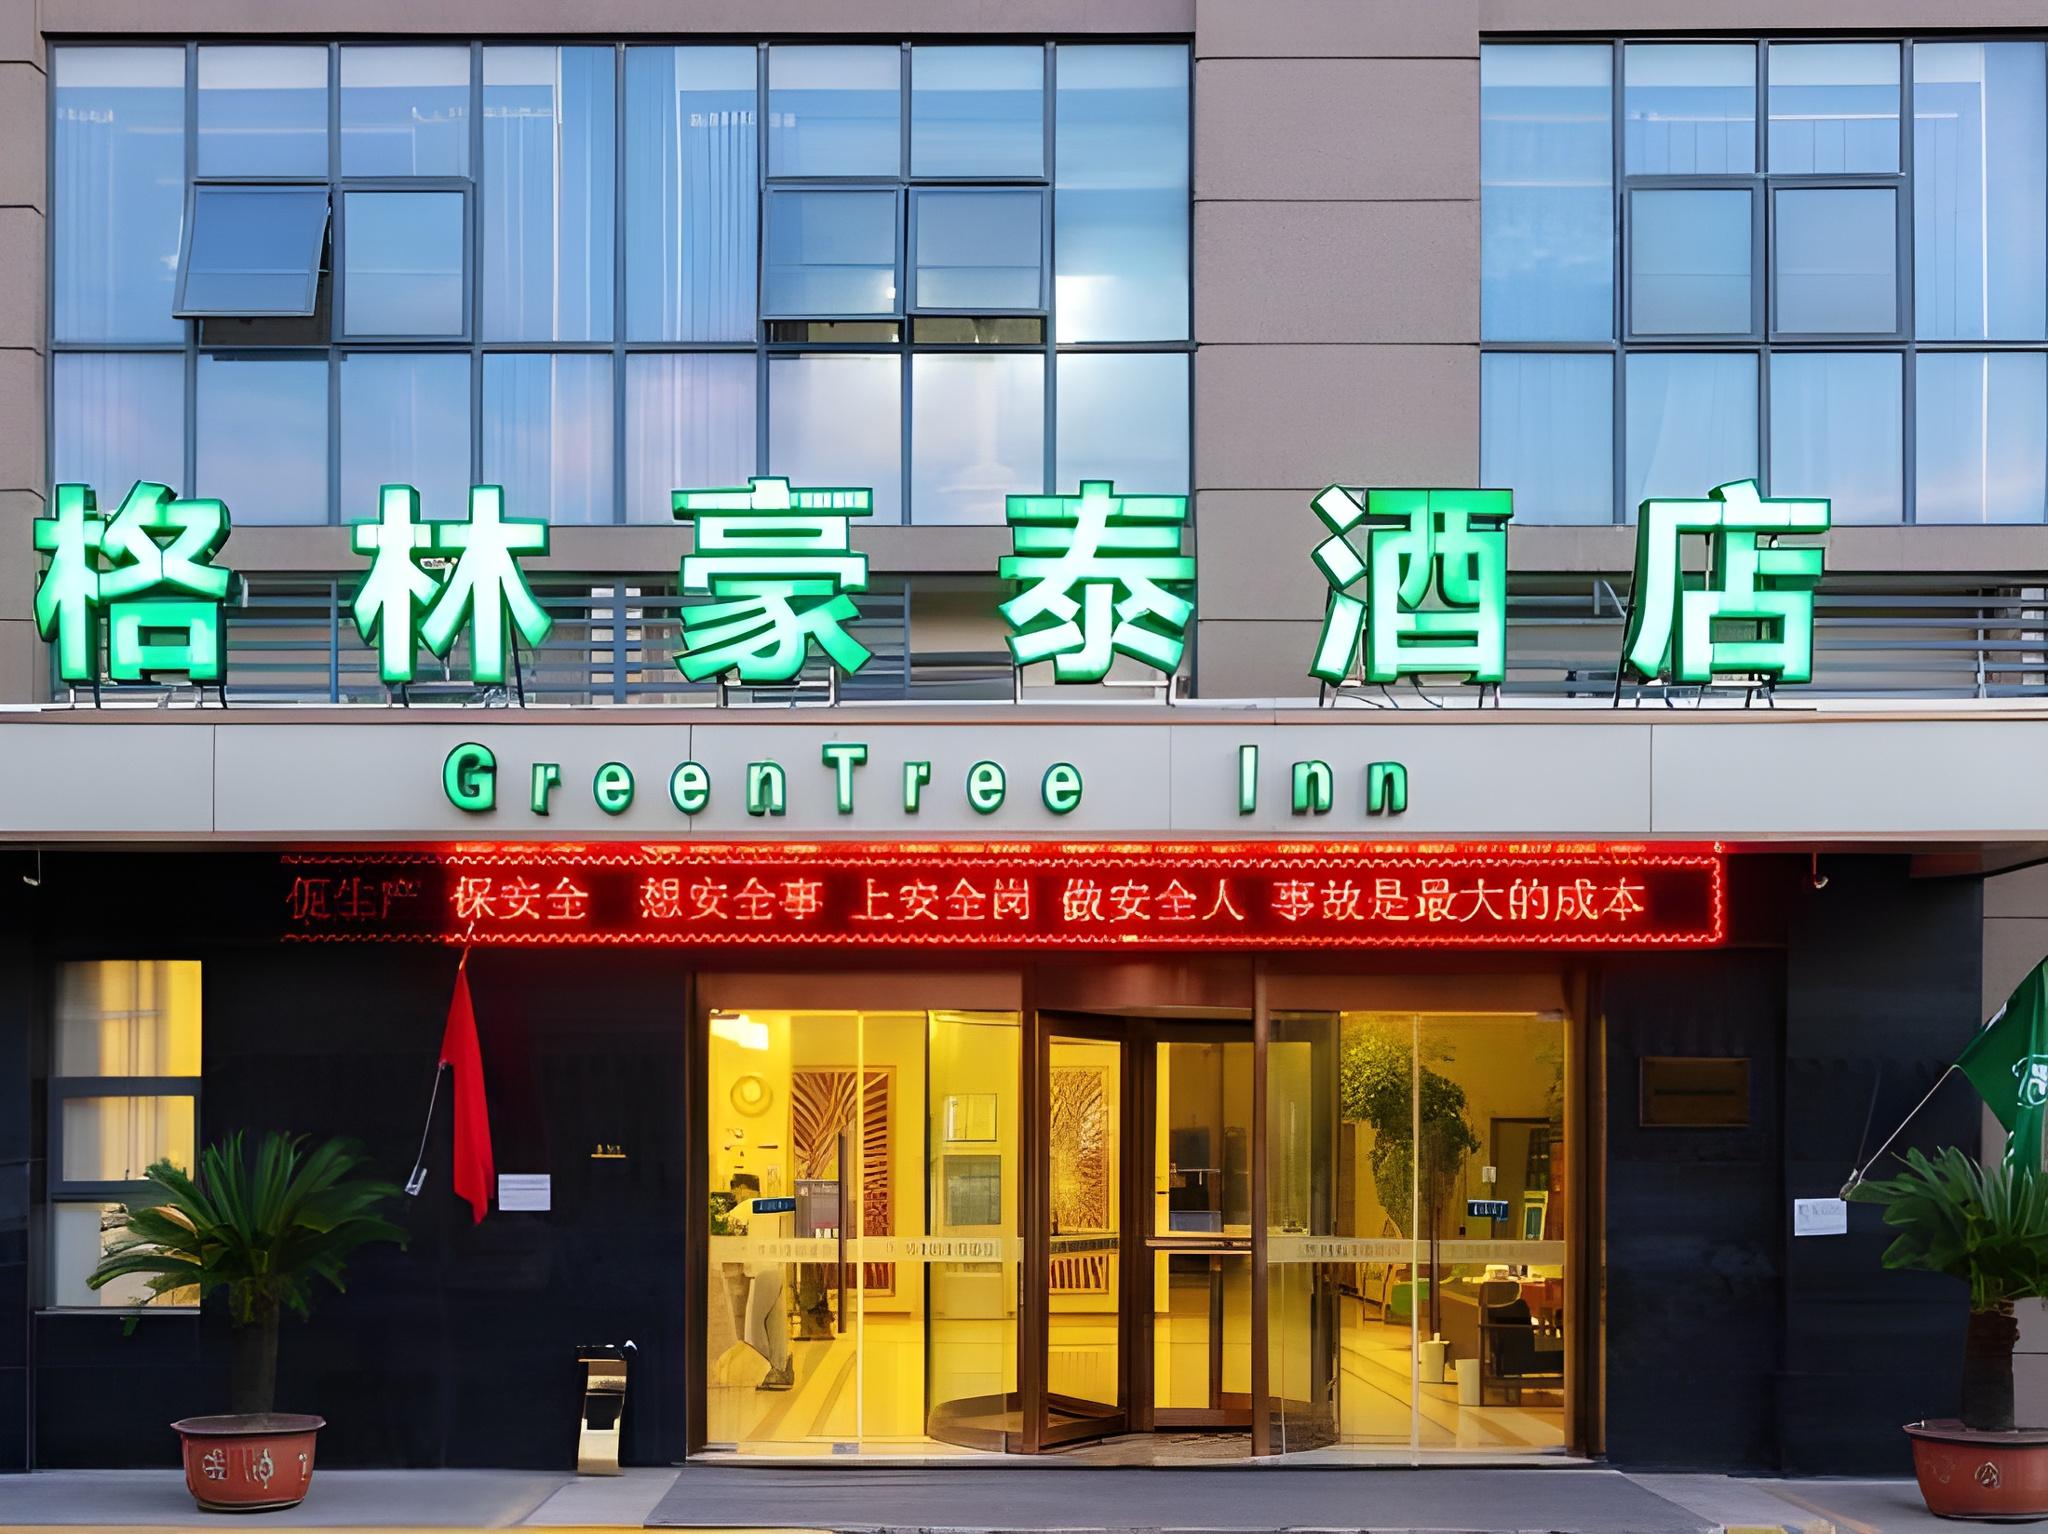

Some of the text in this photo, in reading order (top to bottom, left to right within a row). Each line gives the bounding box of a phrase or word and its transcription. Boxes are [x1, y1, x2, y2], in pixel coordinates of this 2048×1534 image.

[34, 476, 1831, 685] 格林豪泰酒店
[442, 741, 1408, 816] GreenTree Inn
[450, 876, 589, 920] 保安全
[639, 876, 823, 920] 想安全事
[849, 877, 1030, 922] 上安全岗
[1062, 877, 1244, 922] 做安全人
[1271, 876, 1645, 922] 事故是最大的成本
